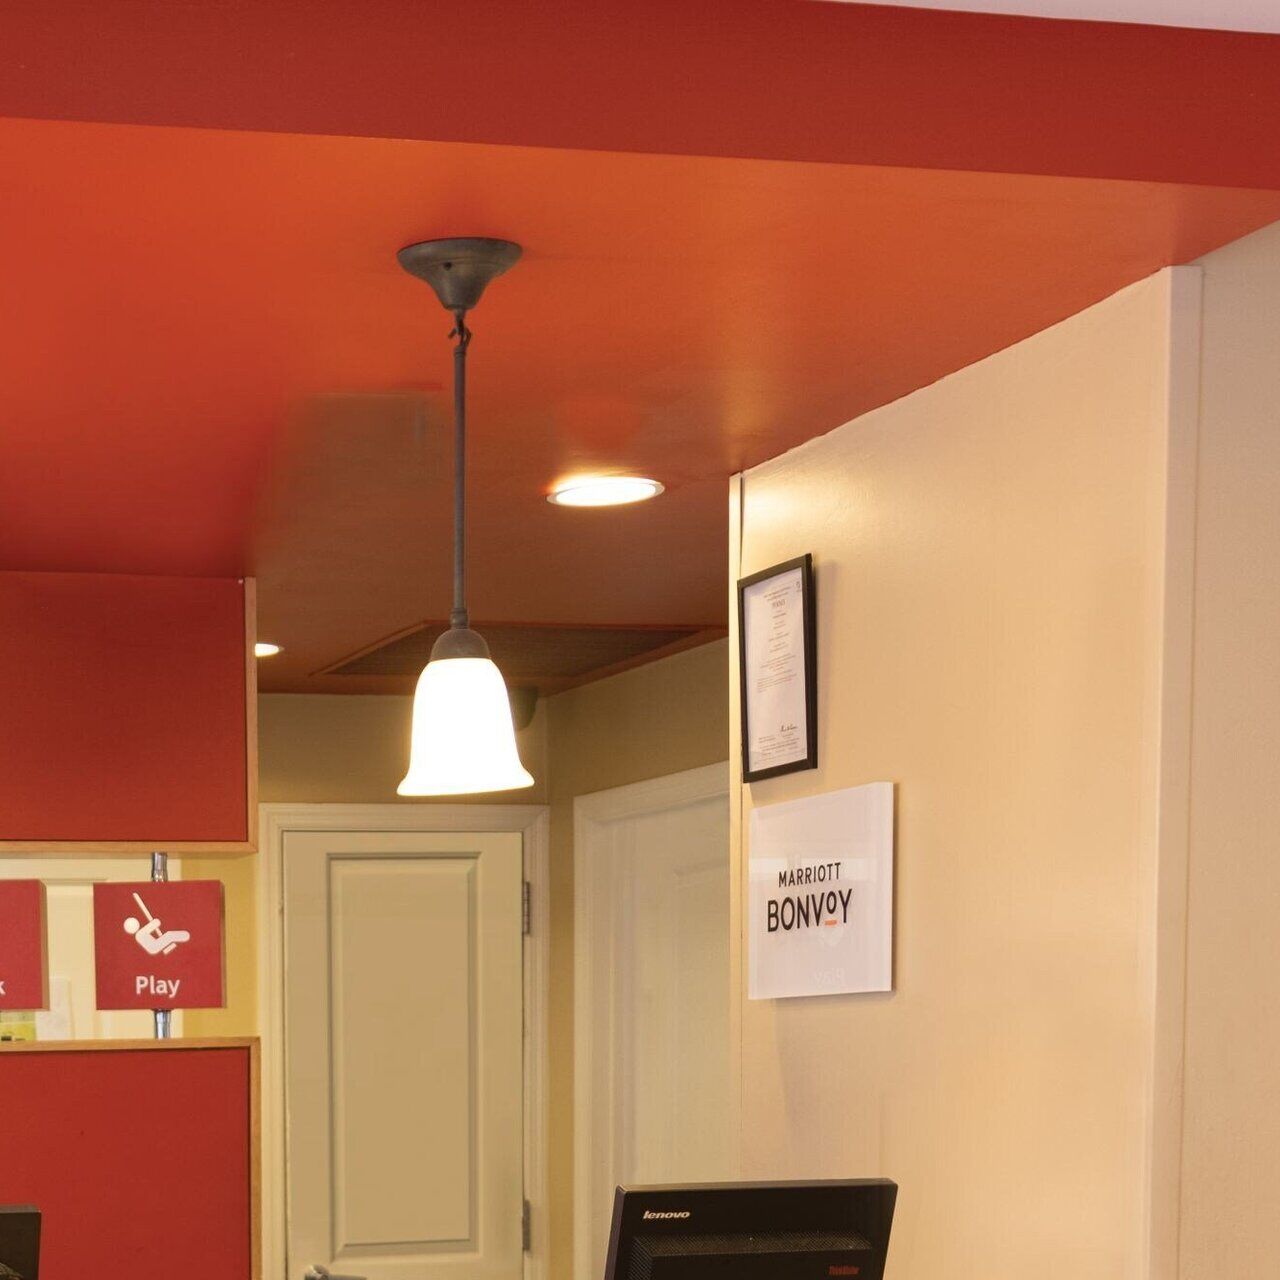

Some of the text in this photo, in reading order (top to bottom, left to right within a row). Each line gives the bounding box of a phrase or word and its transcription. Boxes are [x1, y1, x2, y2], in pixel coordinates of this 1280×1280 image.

[778, 862, 841, 888] MARRIOTT
[767, 888, 853, 932] BONVOY
[135, 975, 180, 999] Play
[643, 1209, 691, 1220] lenovo
